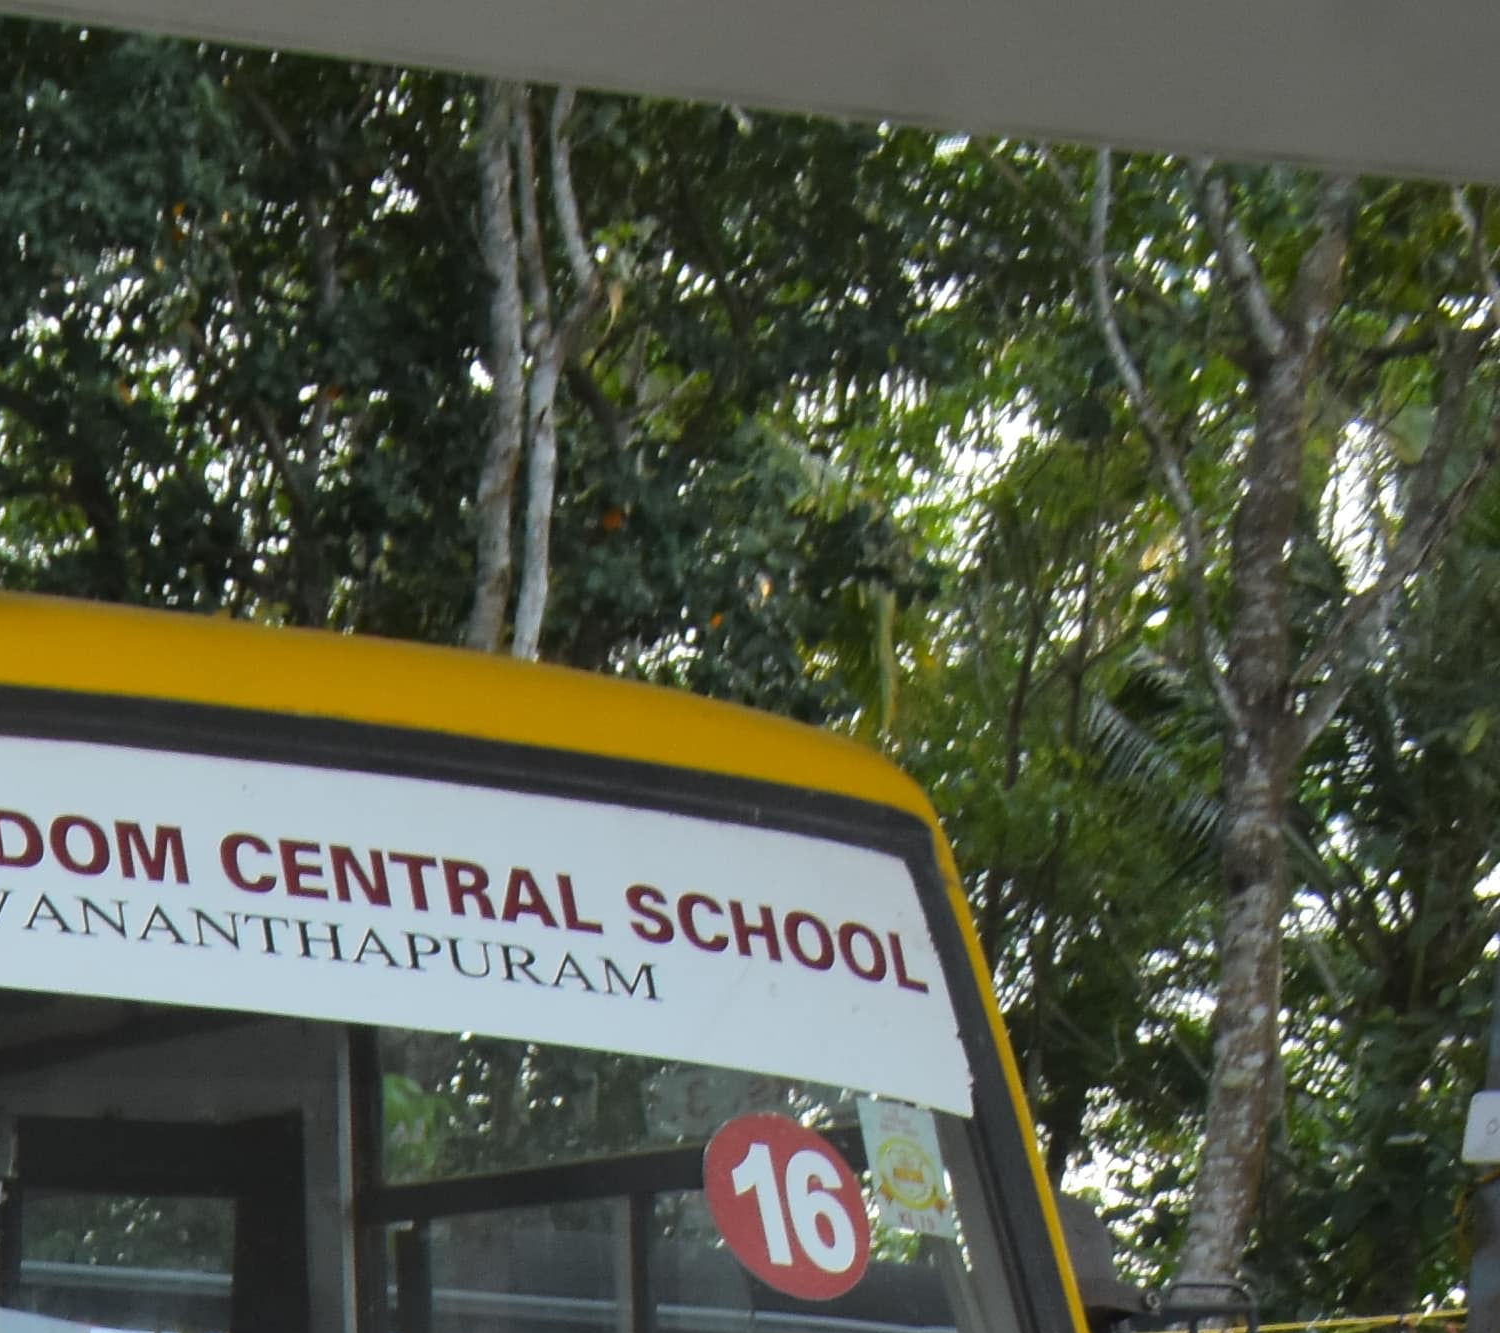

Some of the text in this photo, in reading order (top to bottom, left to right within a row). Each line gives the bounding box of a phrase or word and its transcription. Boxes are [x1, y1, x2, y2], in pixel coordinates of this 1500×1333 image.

[219, 831, 604, 936] CENTRAL
[624, 882, 929, 995] SCHOOL
[731, 1142, 856, 1274] 16
